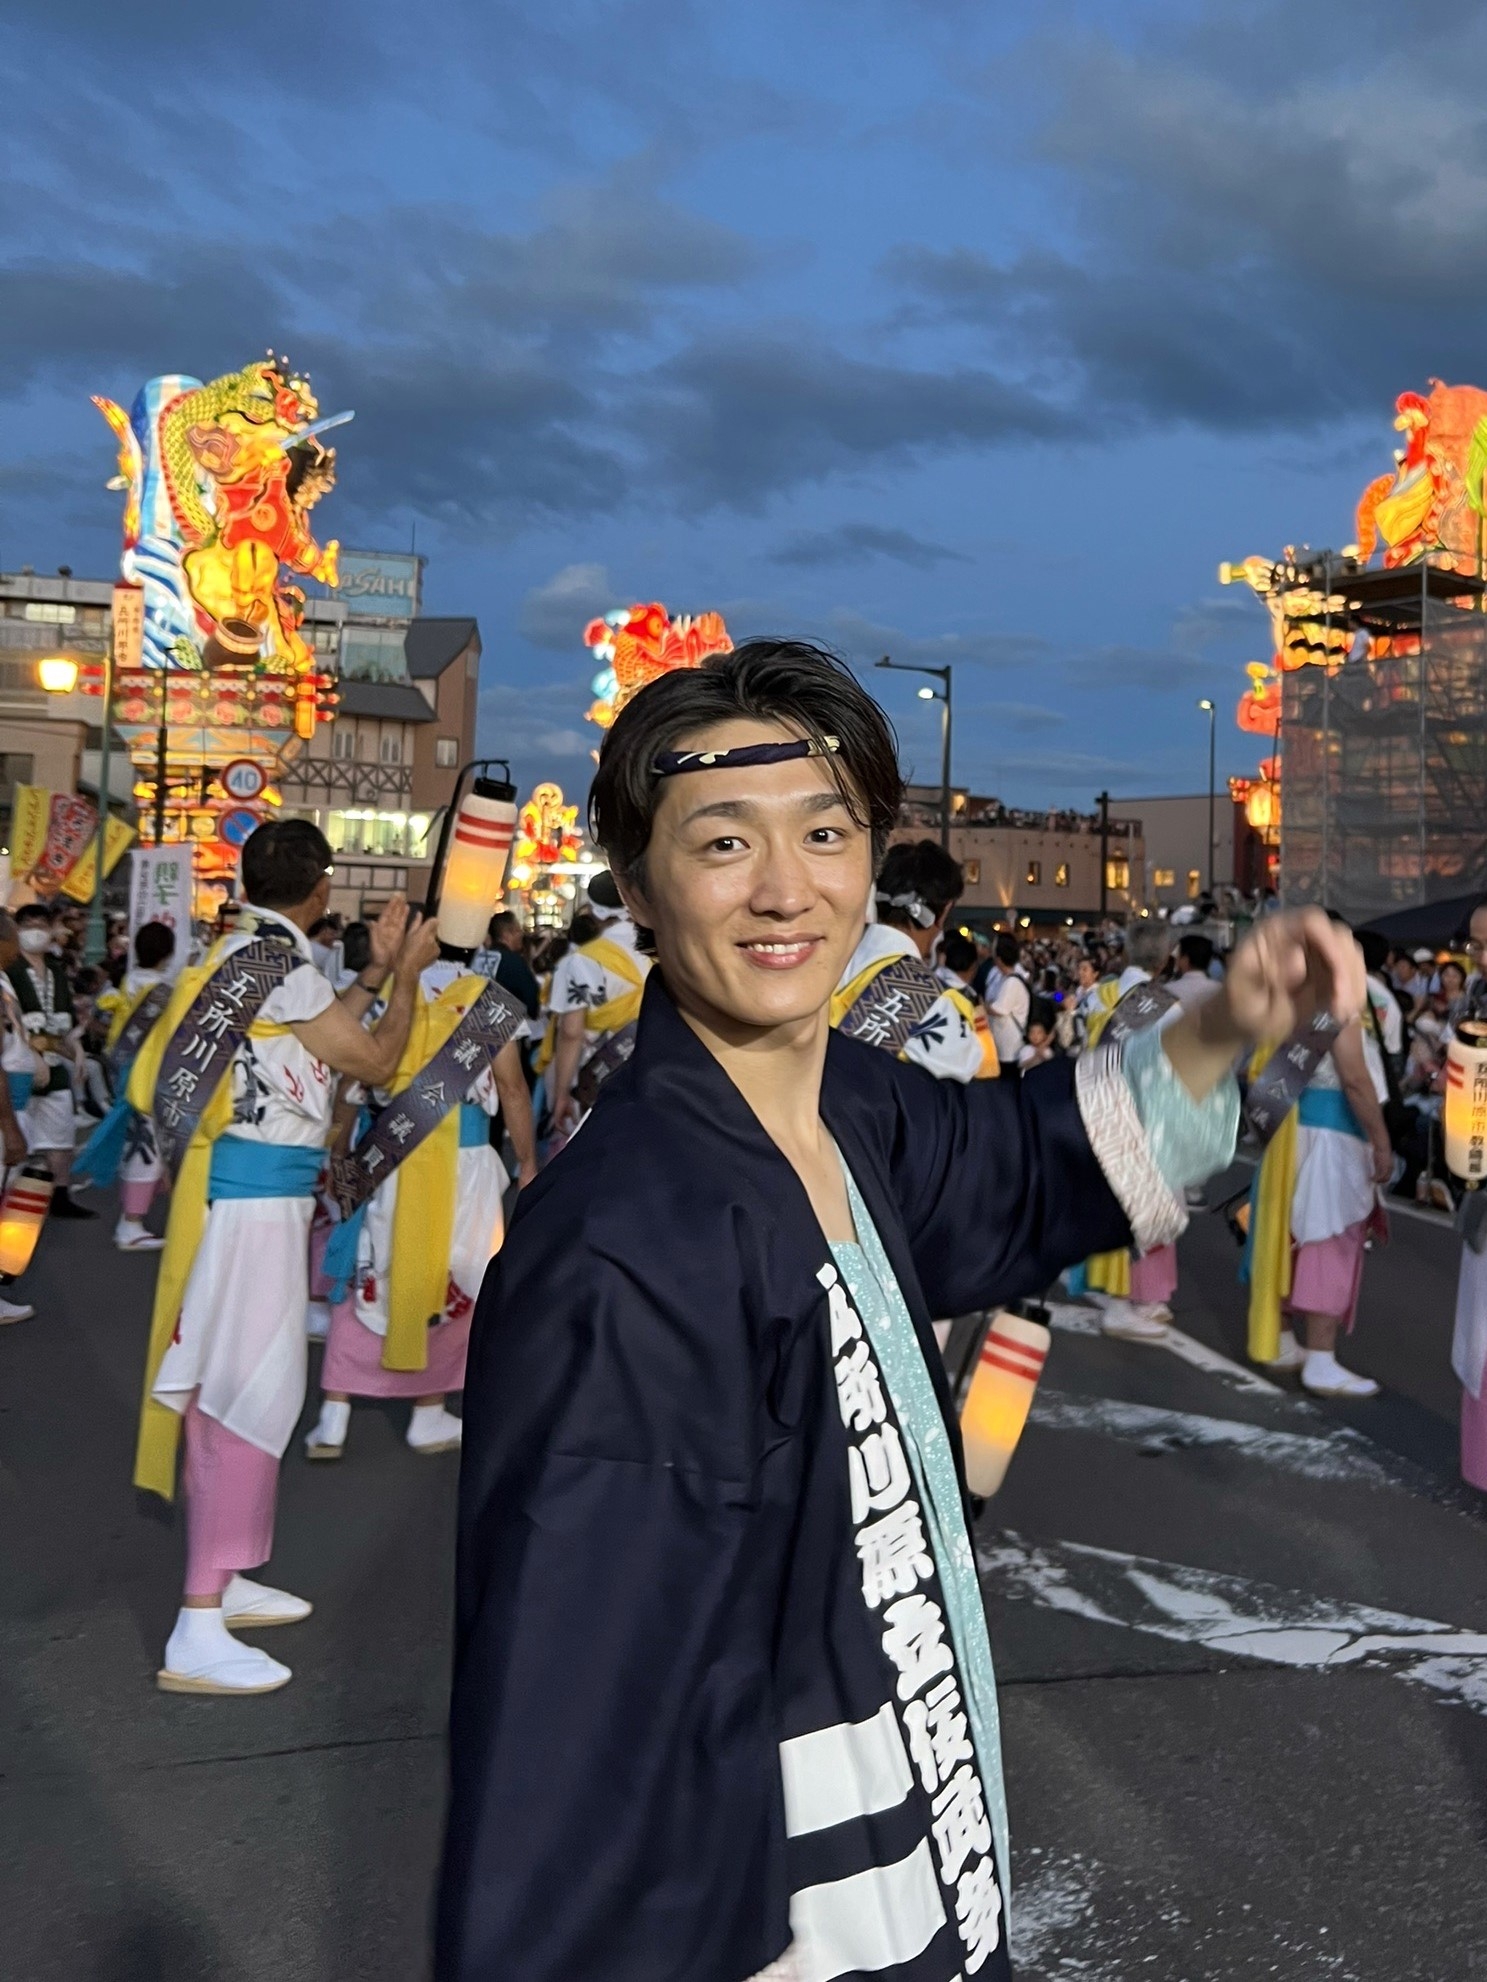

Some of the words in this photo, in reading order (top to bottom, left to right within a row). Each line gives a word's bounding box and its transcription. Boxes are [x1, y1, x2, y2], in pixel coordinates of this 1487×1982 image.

[231, 772, 258, 789] 40
[156, 971, 256, 1160] 五所川原市
[853, 989, 911, 1047] 五所
[362, 1001, 512, 1175] 市議会議員
